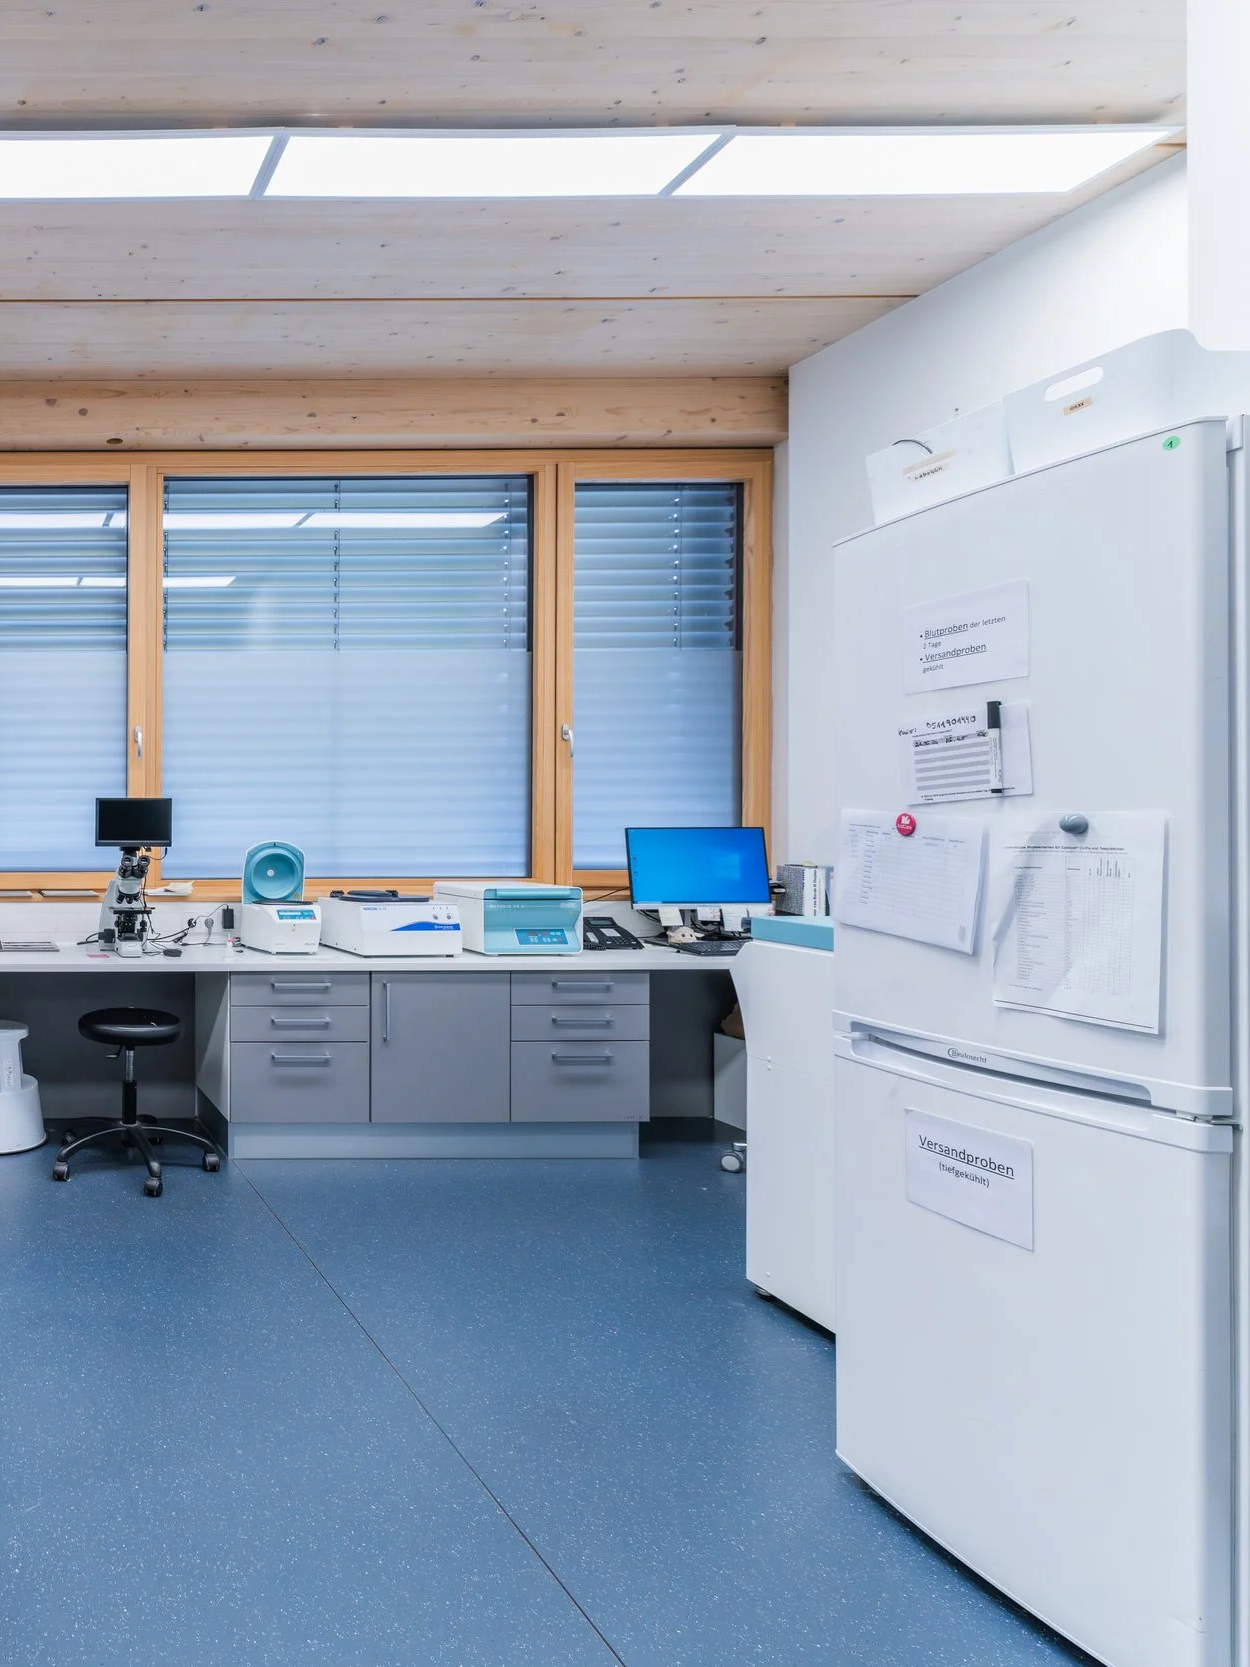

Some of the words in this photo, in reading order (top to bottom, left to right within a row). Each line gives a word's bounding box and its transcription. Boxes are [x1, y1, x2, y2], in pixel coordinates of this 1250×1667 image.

[924, 622, 968, 640] Blutproben
[969, 620, 980, 629] der
[982, 615, 1006, 626] letzten
[924, 643, 987, 662] Versandproben
[928, 640, 942, 649] Tage
[922, 663, 944, 674] gekühlt
[919, 1134, 1015, 1178] Versandproben
[939, 1161, 990, 1188] (tiefgekühlt)
